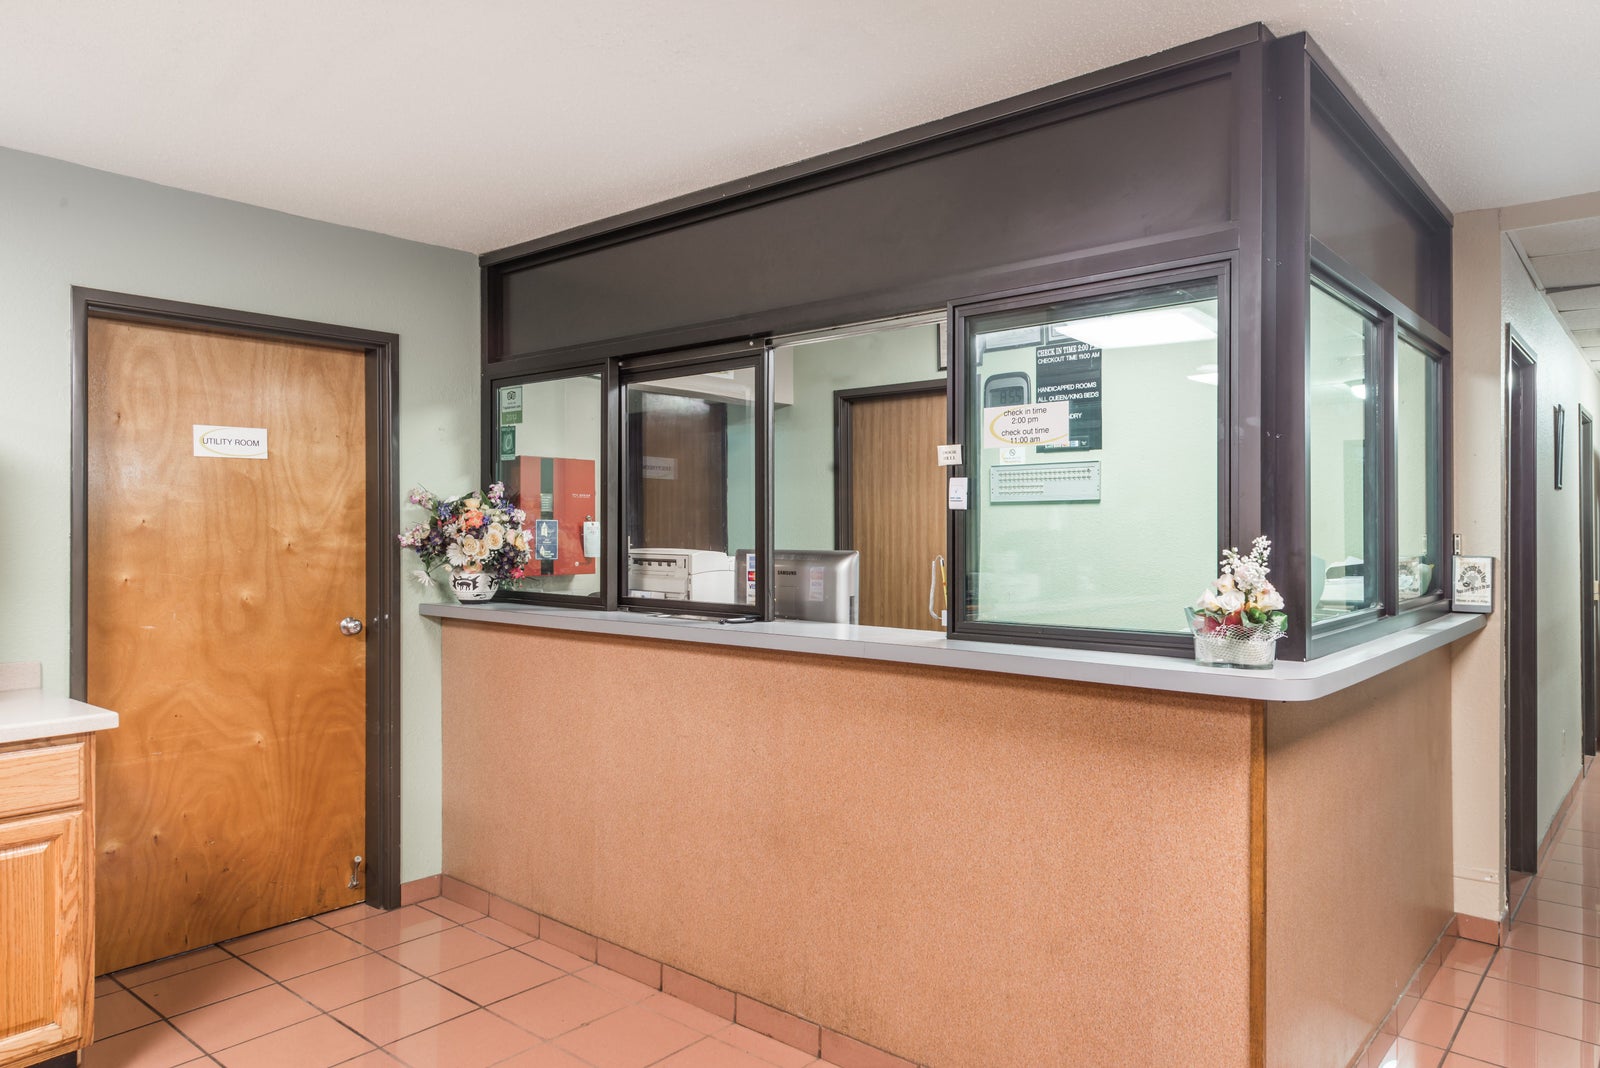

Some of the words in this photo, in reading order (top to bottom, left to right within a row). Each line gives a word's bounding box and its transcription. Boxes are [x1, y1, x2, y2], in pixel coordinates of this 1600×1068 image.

[1037, 348, 1055, 357] CHECK
[1056, 347, 1062, 355] IN
[1063, 345, 1076, 353] TIME
[1038, 384, 1074, 393] HANDICAPPED
[1003, 408, 1023, 417] check
[1001, 429, 1021, 437] check
[203, 437, 232, 446] UTILITY
[234, 439, 260, 447] ROOM
